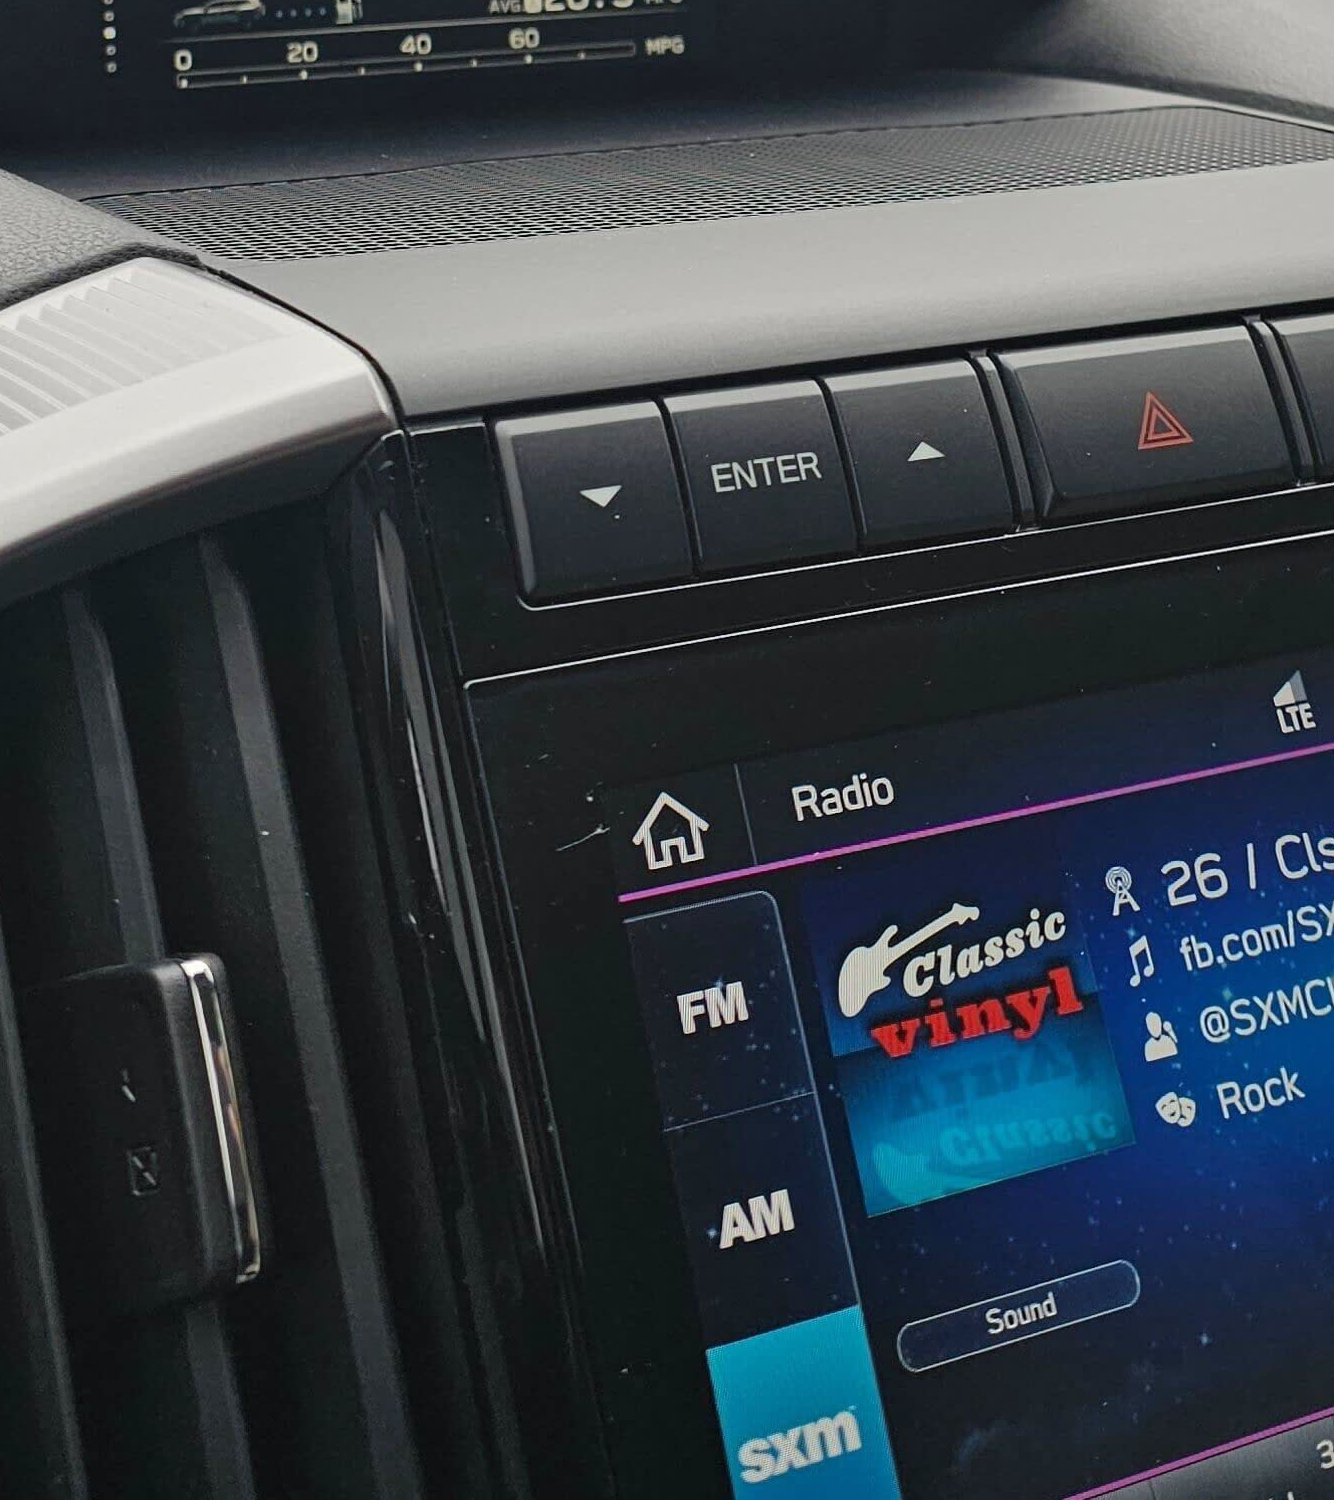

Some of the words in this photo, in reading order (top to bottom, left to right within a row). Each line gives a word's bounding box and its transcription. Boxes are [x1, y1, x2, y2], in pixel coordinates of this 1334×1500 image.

[174, 49, 192, 72] 0
[287, 41, 318, 64] 20
[400, 33, 433, 56] 40
[508, 27, 540, 49] 60
[644, 35, 685, 56] MPG
[711, 452, 822, 493] ENTER
[1275, 703, 1315, 733] LTE
[792, 773, 894, 821] Radio
[1161, 853, 1228, 906] 26
[903, 907, 1066, 998] Classic
[677, 981, 748, 1034] FM
[871, 967, 1083, 1058] vinyl
[1217, 1069, 1305, 1119] Rock
[719, 1189, 794, 1249] AM
[986, 1293, 1057, 1335] Sound
[738, 1407, 862, 1484] sxm
